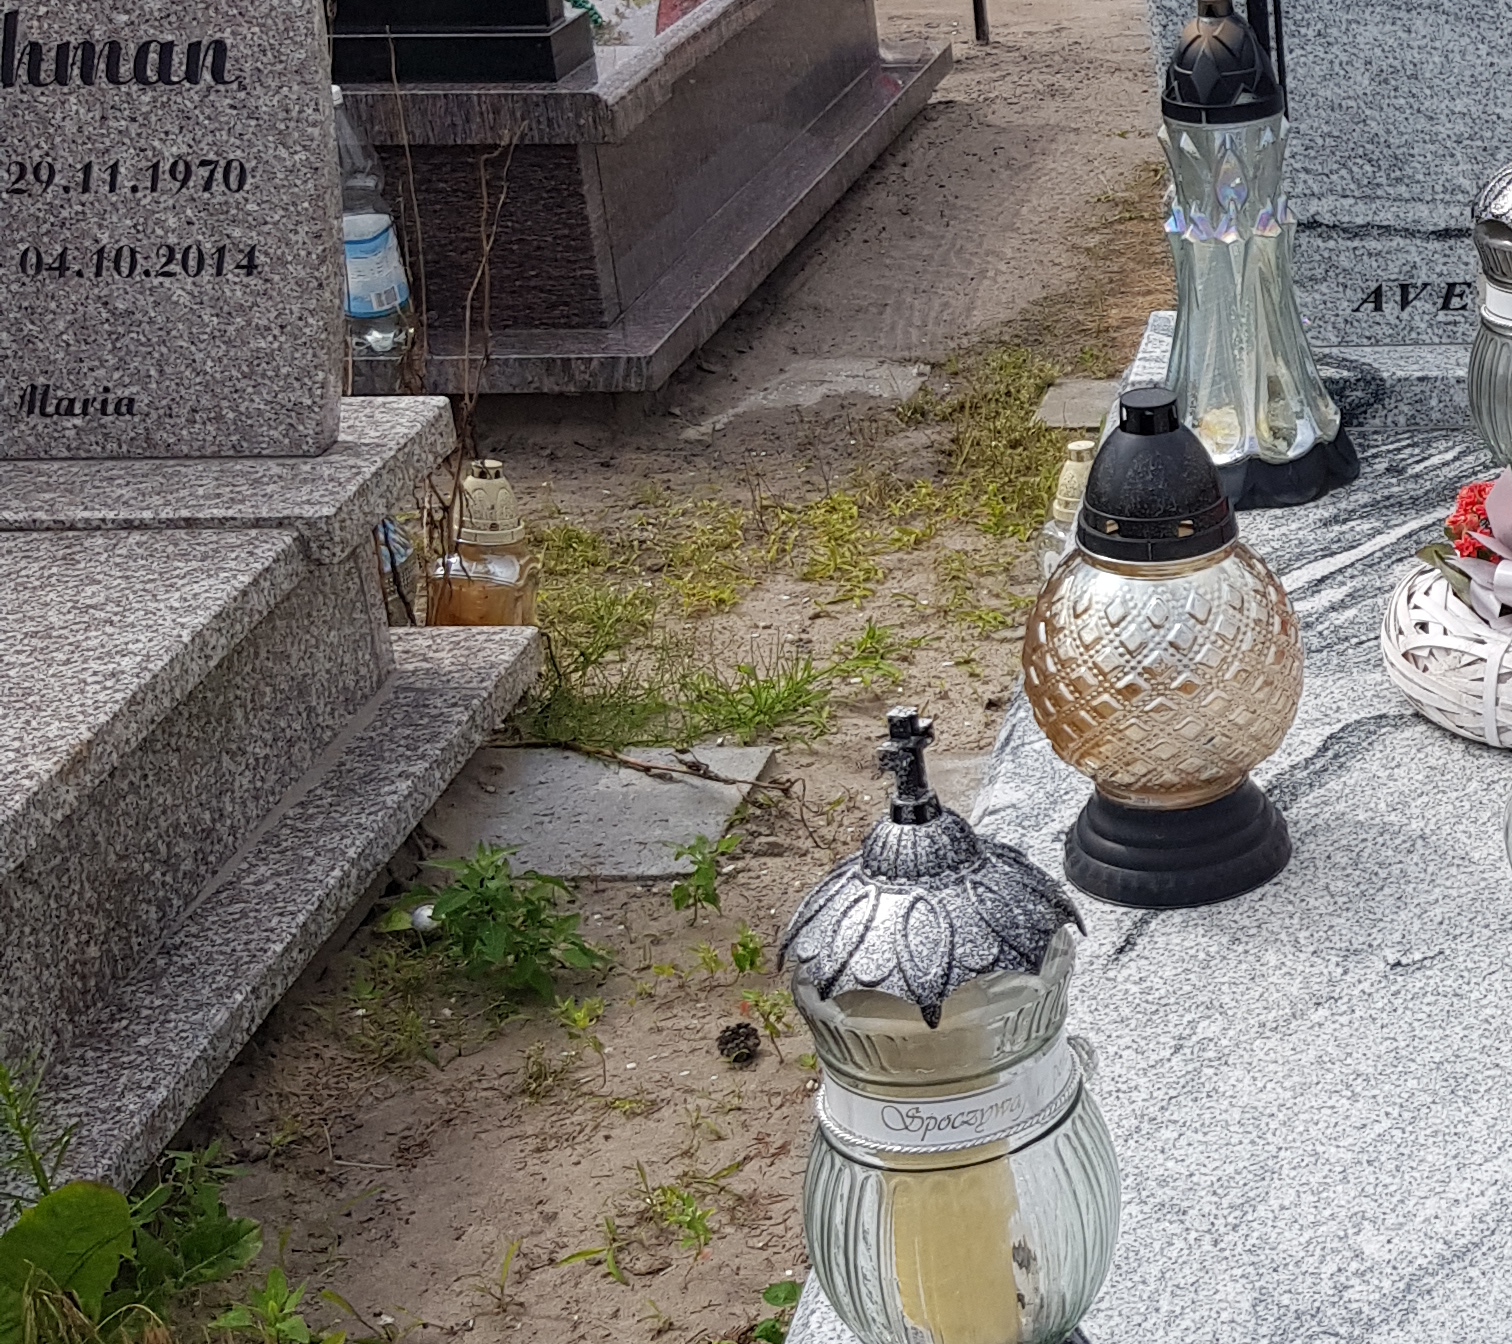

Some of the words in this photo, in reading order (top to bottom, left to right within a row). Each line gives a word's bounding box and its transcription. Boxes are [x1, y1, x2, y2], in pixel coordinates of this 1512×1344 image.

[0, 9, 240, 90] hman
[6, 158, 248, 197] 29.11.1970
[19, 243, 259, 279] 04.10.2014
[1351, 281, 1473, 314] AVE
[18, 383, 139, 418] Maria
[880, 1094, 1027, 1142] Spoczywaj
